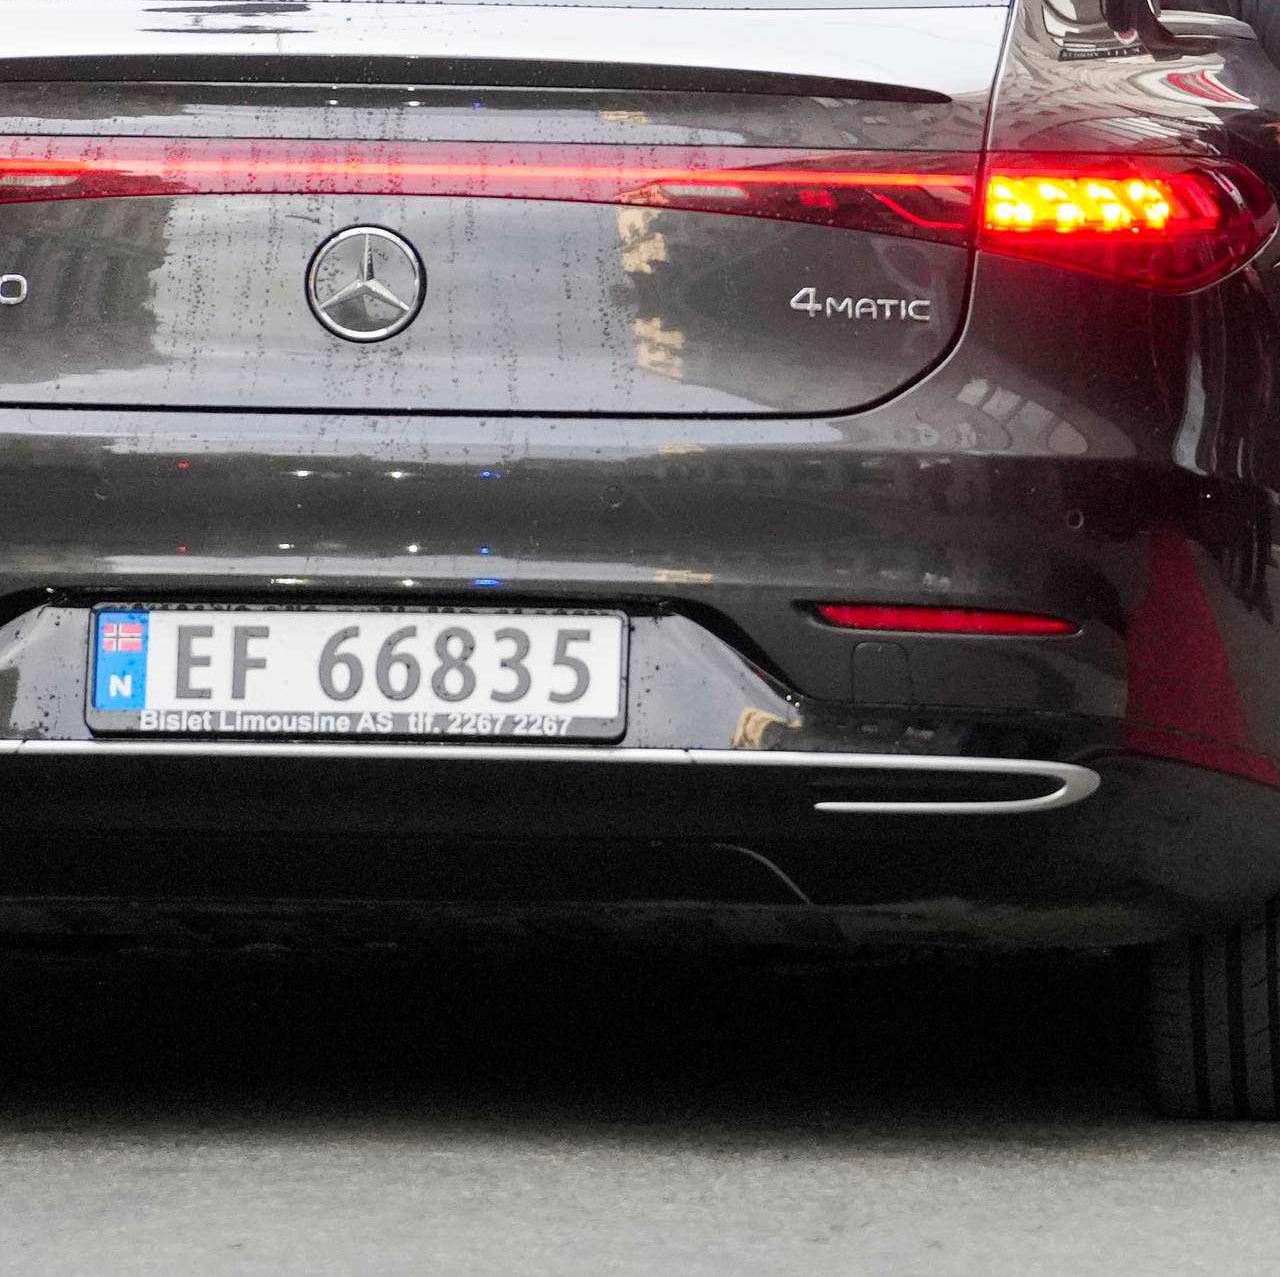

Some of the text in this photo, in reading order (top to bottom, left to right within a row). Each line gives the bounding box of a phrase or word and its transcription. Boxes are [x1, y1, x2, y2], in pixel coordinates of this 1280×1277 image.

[790, 286, 932, 321] 4MATIC
[175, 625, 591, 703] EF 66835
[108, 673, 133, 698] N
[139, 710, 573, 736] Bislet Limousine AS tlf. 2267 2267
